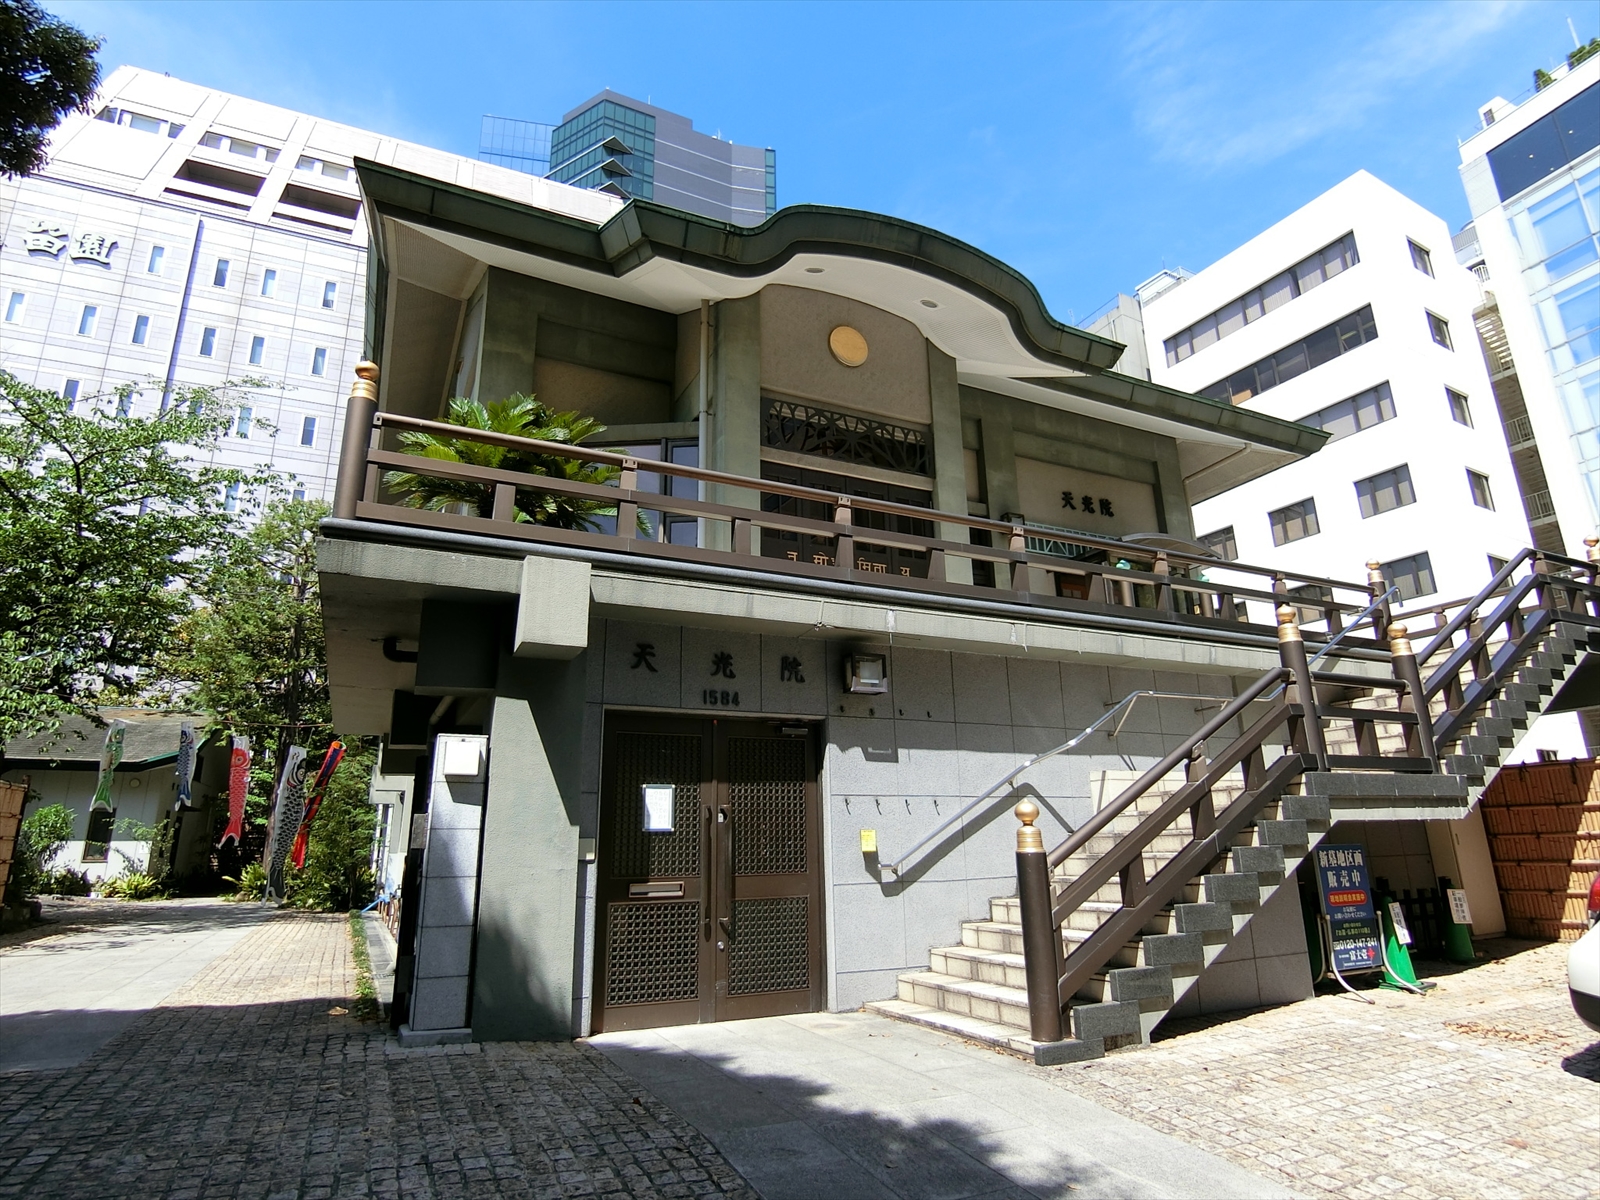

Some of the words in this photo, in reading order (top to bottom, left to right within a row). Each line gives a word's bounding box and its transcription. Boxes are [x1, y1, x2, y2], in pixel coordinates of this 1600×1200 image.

[1061, 491, 1115, 518] 天光院
[630, 643, 806, 684] 天光院
[703, 689, 741, 707] 1584
[1318, 849, 1364, 868] 新墓地区画
[1327, 869, 1361, 888] 販売中
